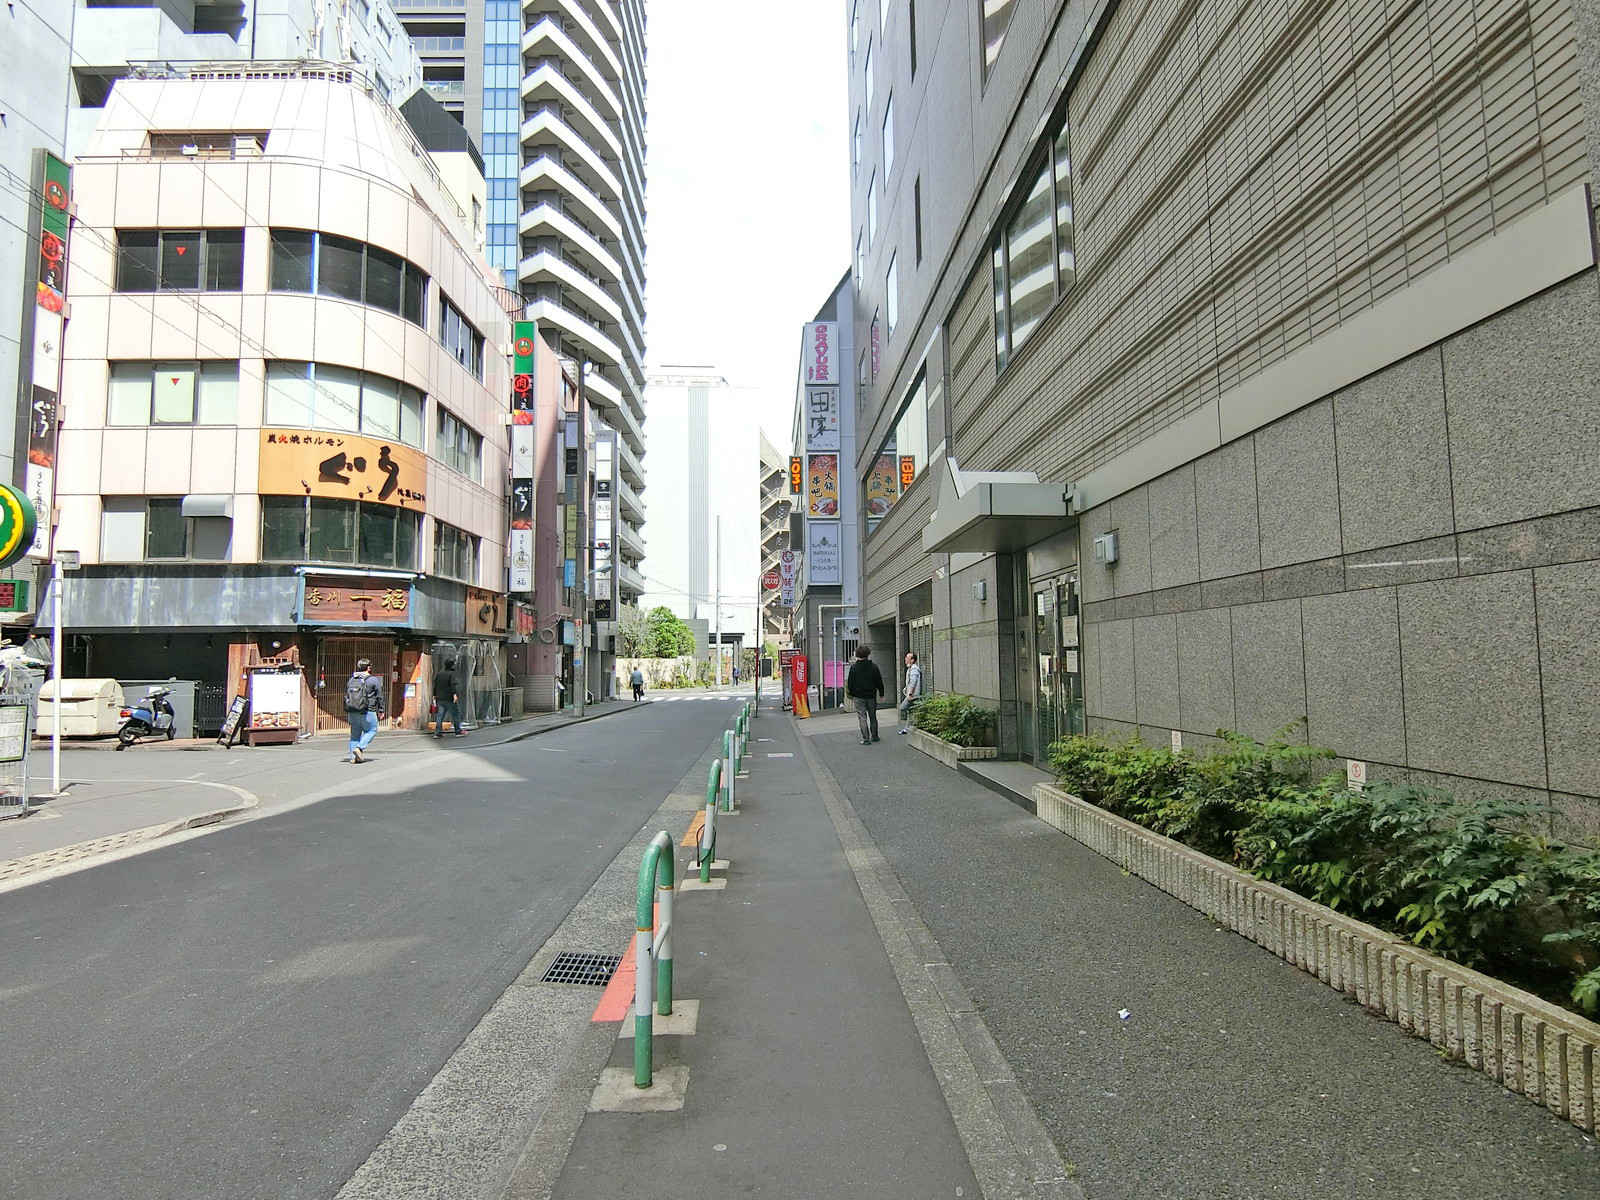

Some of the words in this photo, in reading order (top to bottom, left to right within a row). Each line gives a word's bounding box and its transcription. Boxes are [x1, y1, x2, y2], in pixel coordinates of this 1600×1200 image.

[267, 433, 345, 447] 炭火焼ホルモン
